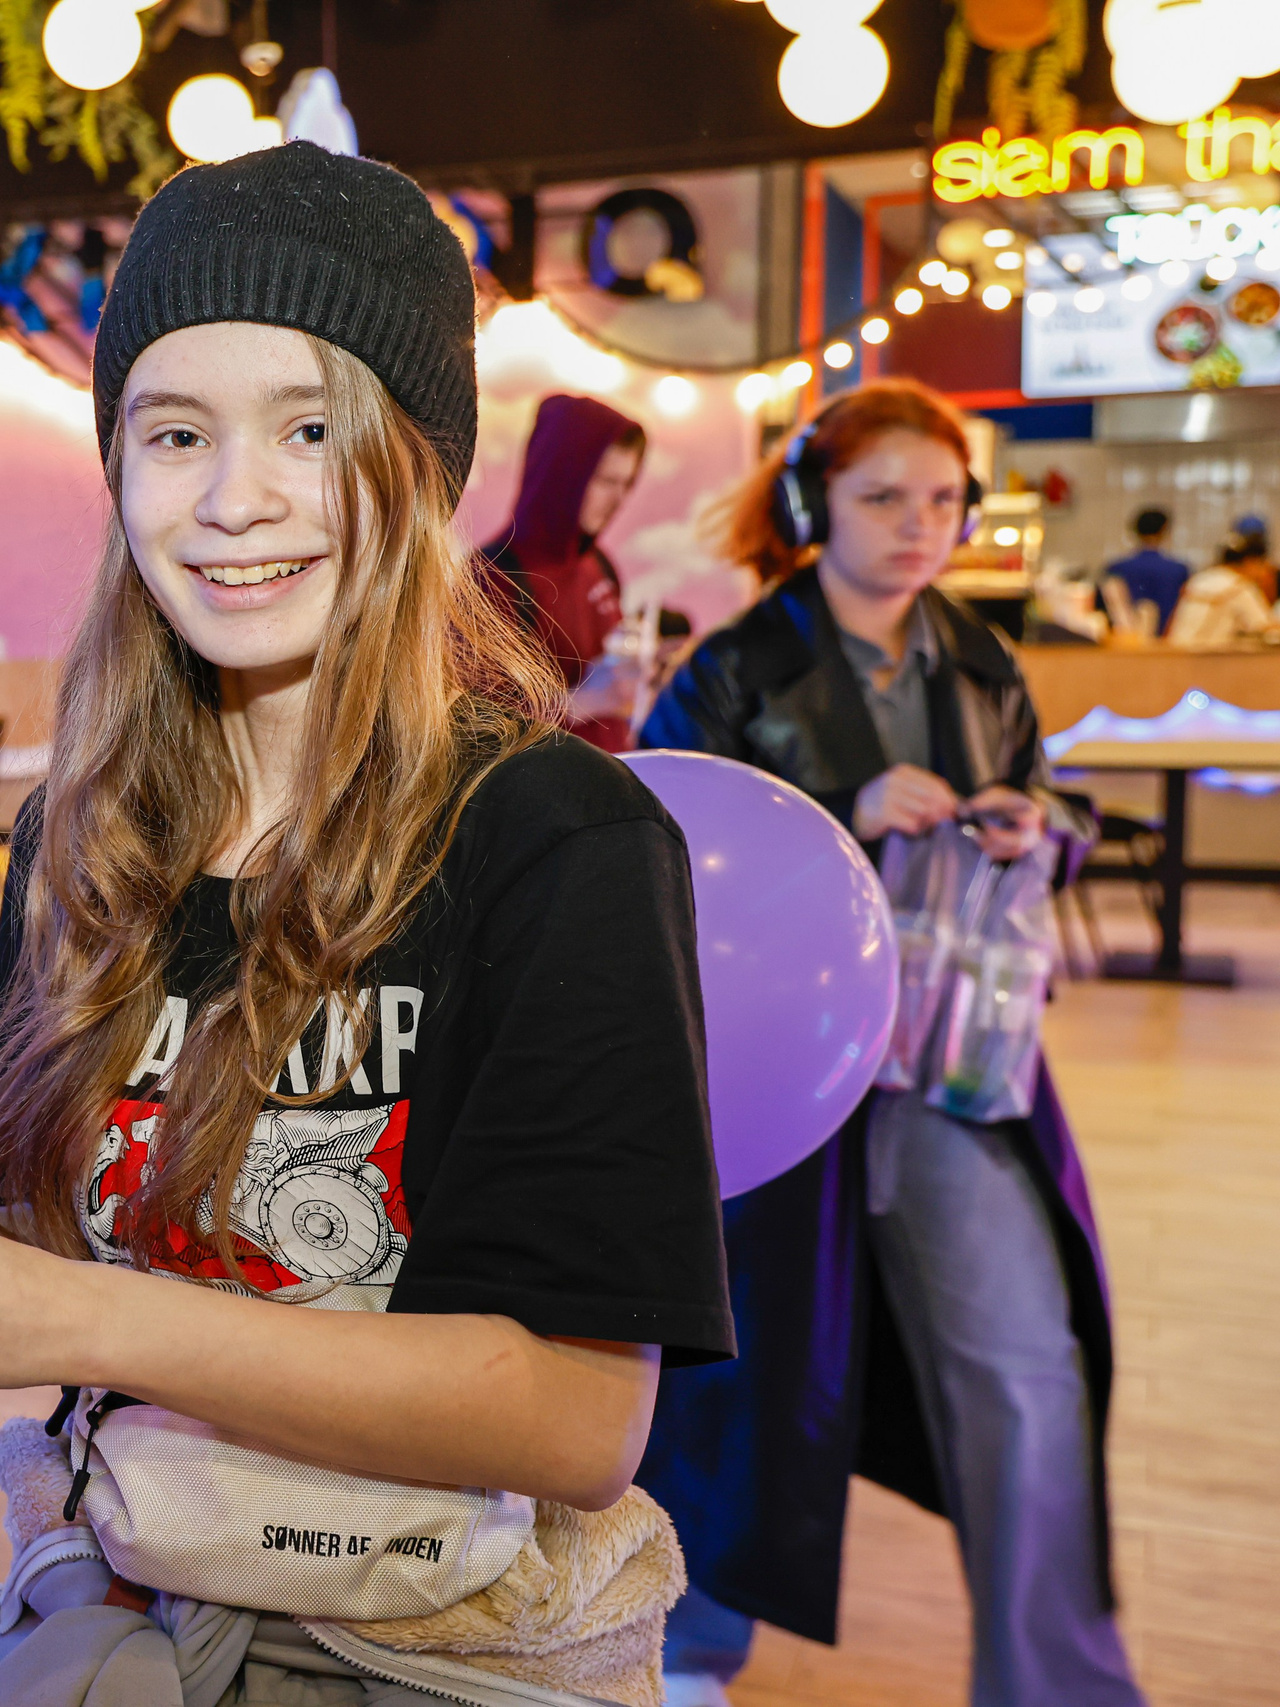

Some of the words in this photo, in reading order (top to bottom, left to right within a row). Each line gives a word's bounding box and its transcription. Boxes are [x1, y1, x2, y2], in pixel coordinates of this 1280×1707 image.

[932, 126, 1144, 203] siam
[1176, 105, 1280, 182] th
[261, 1524, 340, 1557] SØNNER
[347, 1535, 371, 1556] AF
